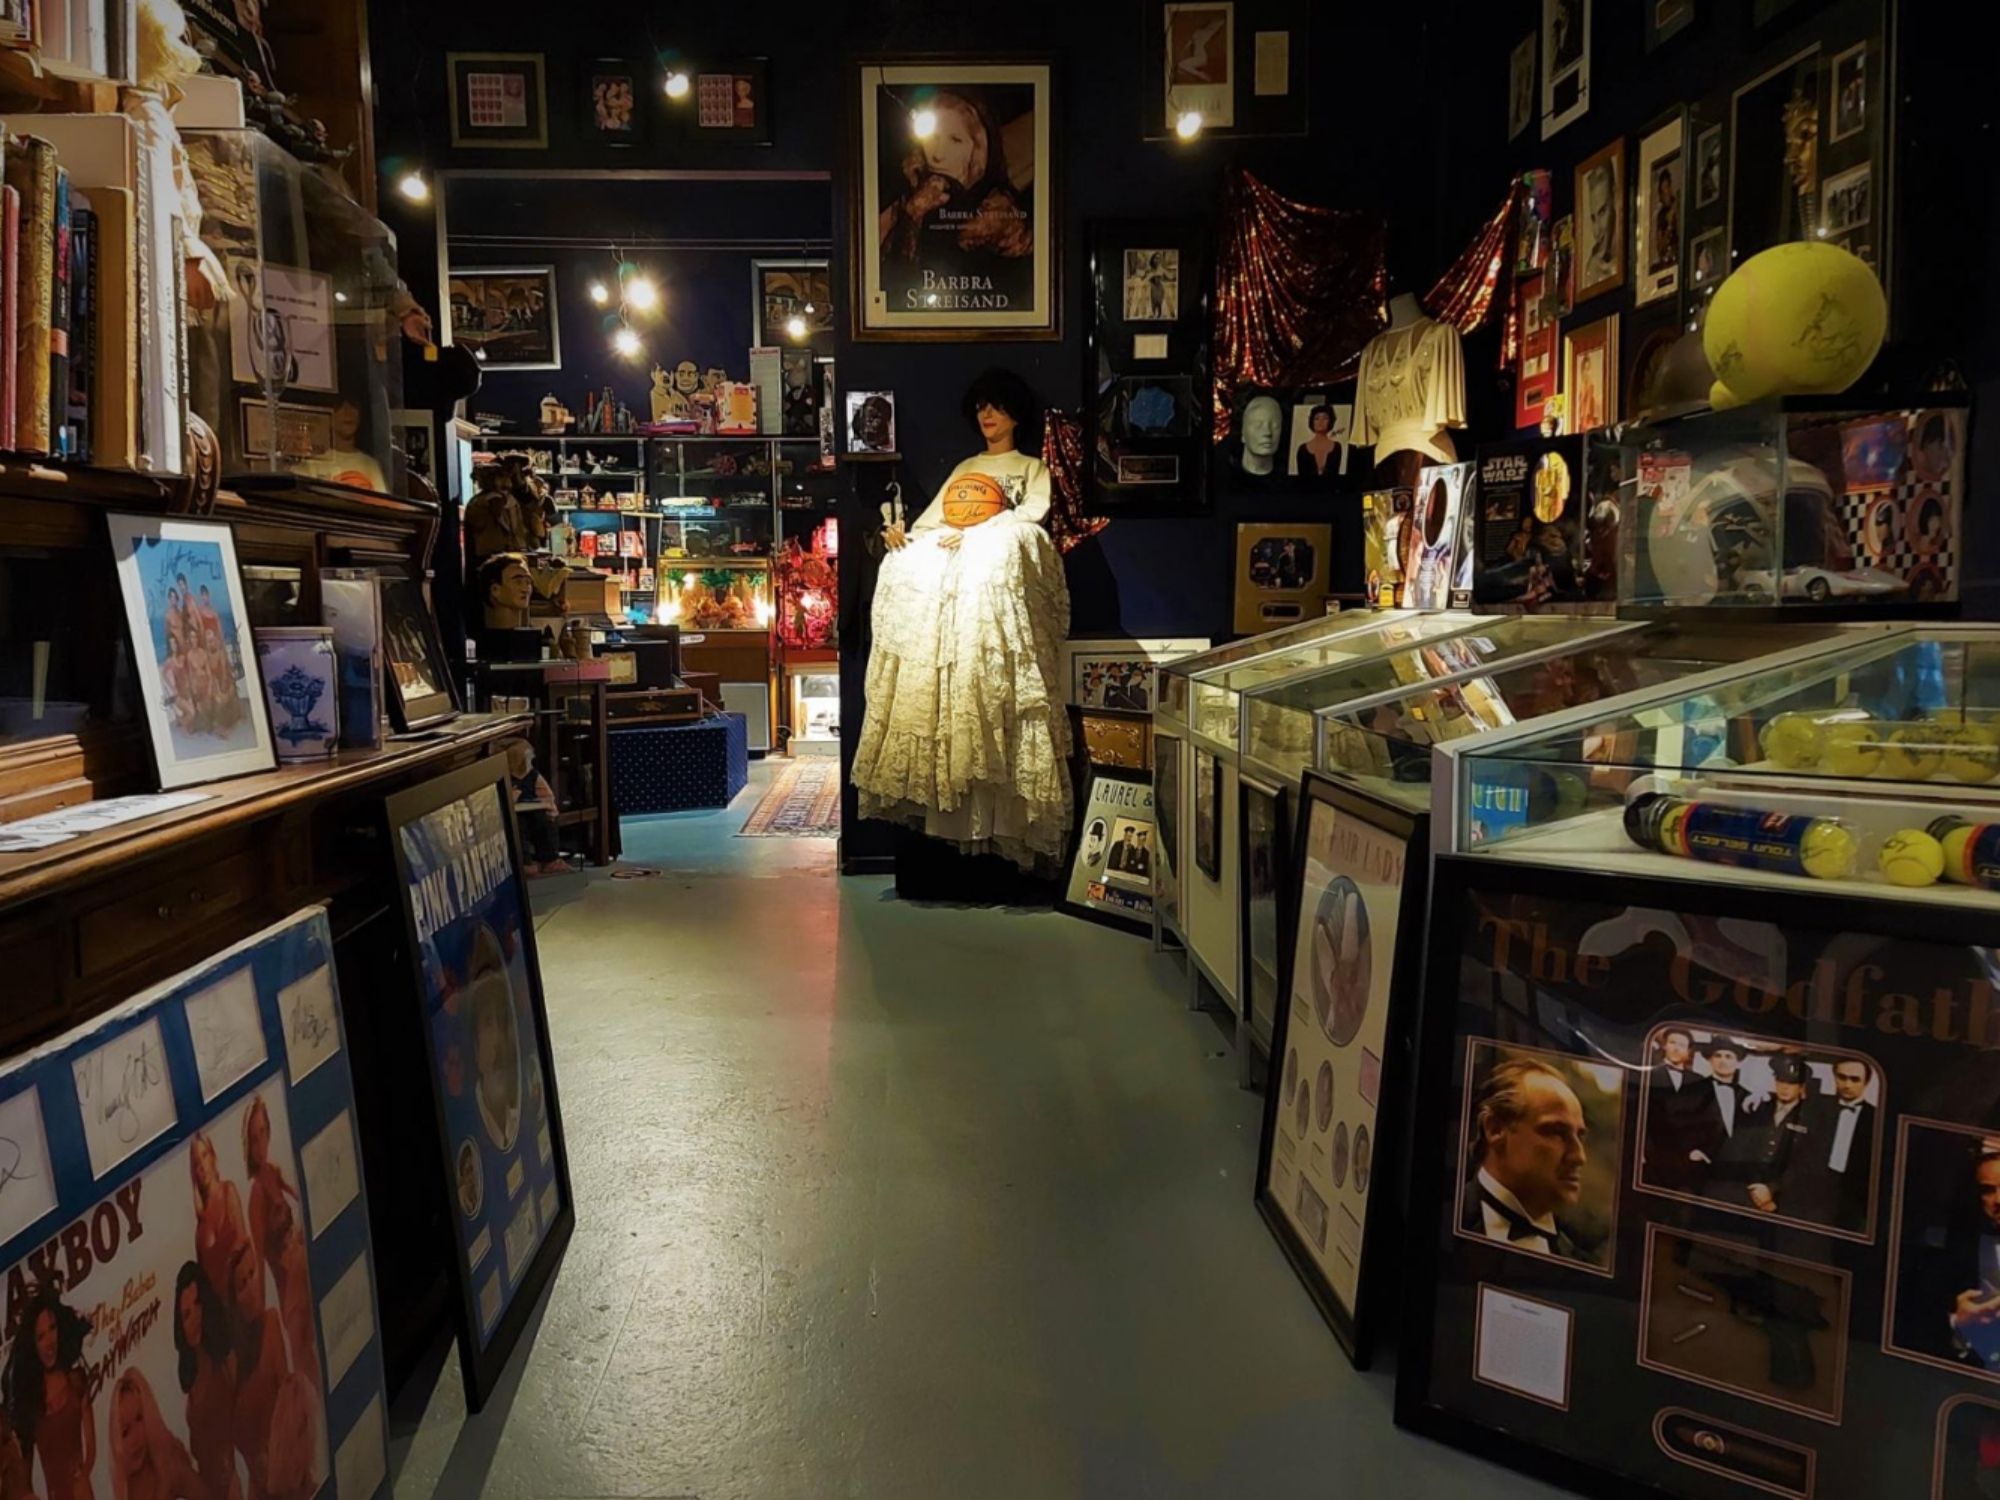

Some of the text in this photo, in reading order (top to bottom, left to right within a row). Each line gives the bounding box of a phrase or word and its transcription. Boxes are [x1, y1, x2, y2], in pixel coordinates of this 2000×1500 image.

[922, 269, 993, 290] BARBRA
[906, 288, 1008, 309] STREISAND
[1482, 454, 1528, 471] STAR
[1482, 467, 1528, 483] WARS
[1095, 782, 1138, 807] LAUREL
[409, 829, 513, 944] PINK PANTHER
[1479, 915, 2000, 1052] The Godfath
[0, 1177, 143, 1346] AYBOY
